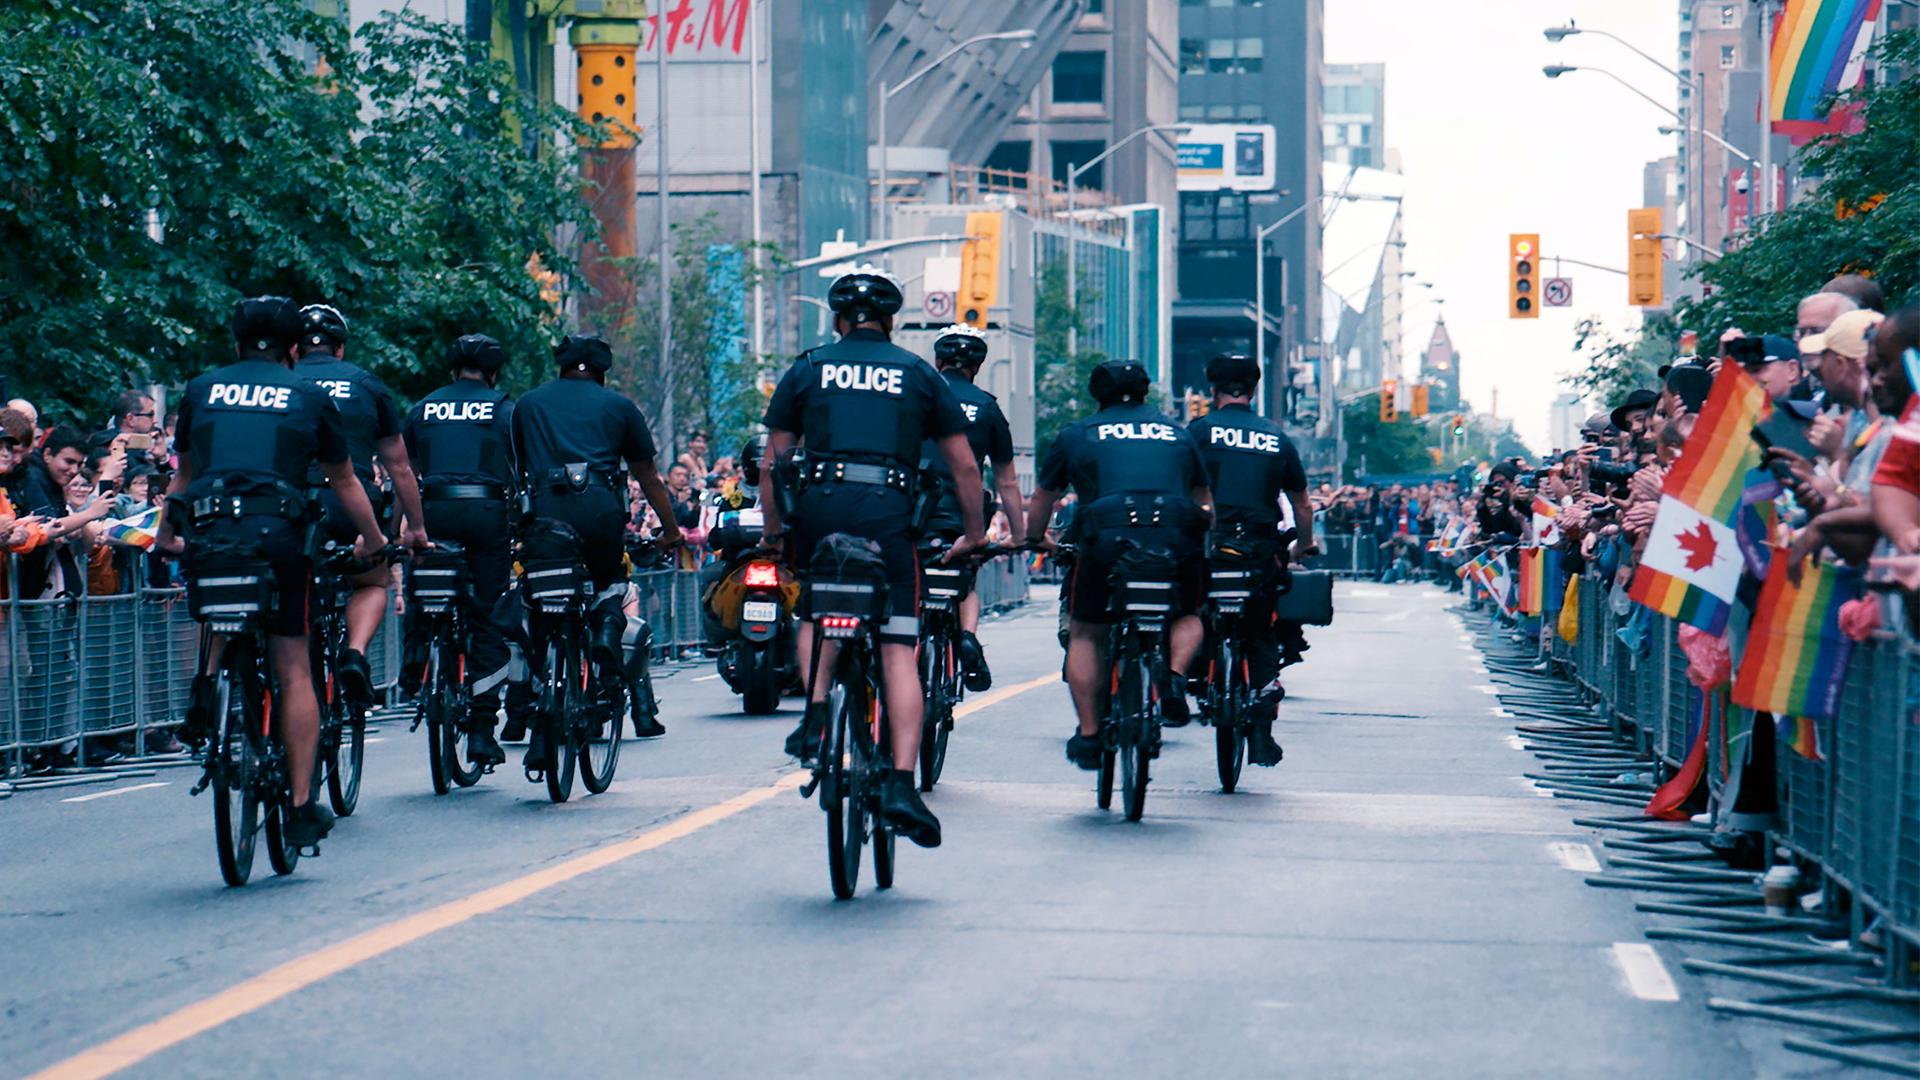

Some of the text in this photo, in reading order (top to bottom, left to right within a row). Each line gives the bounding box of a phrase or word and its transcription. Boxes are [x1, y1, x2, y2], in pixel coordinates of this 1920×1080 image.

[646, 0, 750, 55] H&M
[821, 364, 903, 394] POLICE
[208, 383, 292, 409] POLICE
[424, 402, 494, 420] POLICE
[1098, 422, 1177, 441] POLICE
[1211, 426, 1280, 453] POLICE
